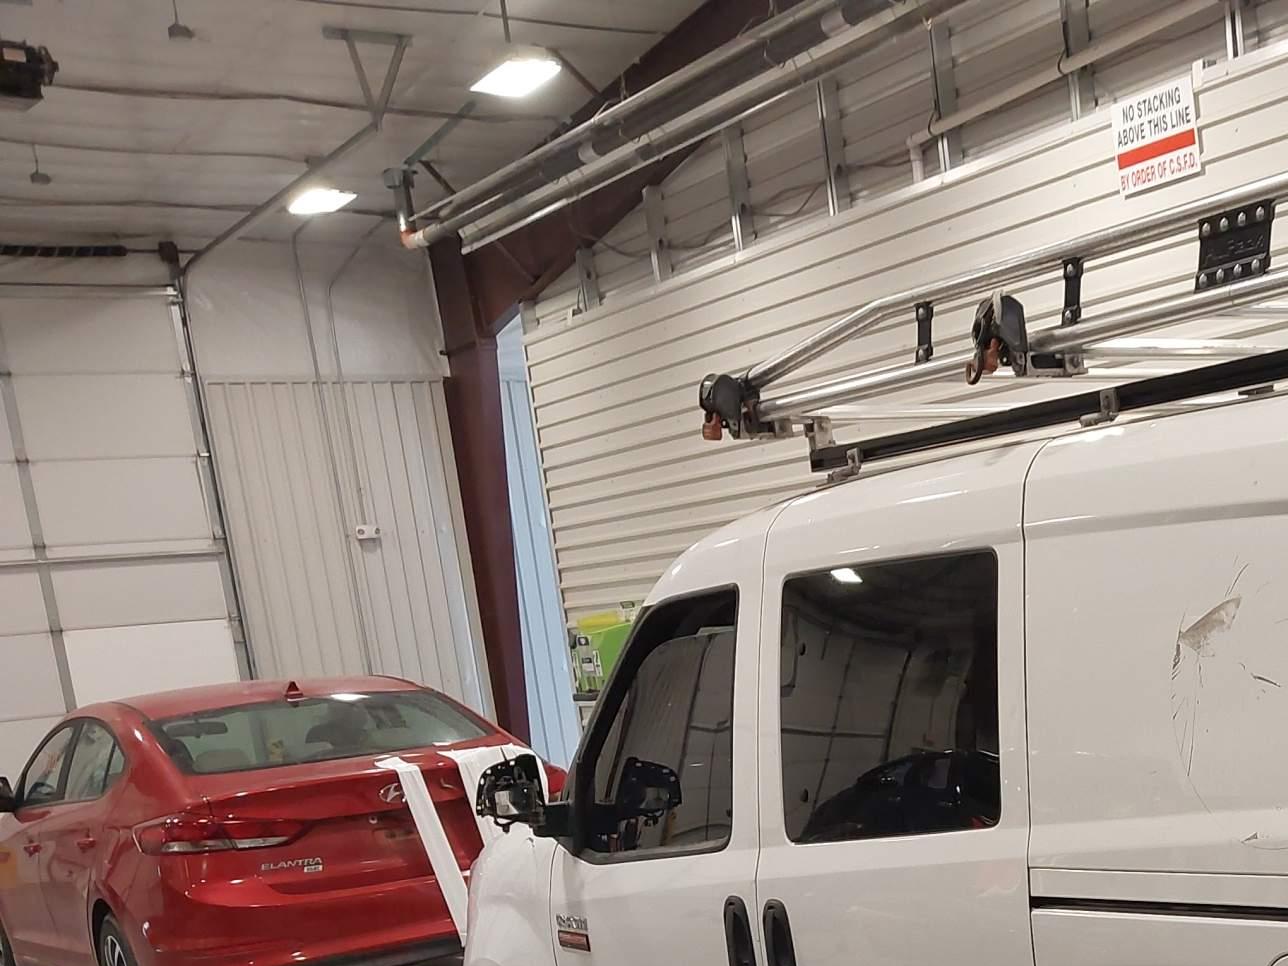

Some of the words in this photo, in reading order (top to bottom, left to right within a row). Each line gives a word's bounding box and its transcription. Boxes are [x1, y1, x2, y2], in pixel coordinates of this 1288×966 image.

[1122, 104, 1135, 124] NO
[1137, 87, 1181, 118] STACKING
[1118, 122, 1146, 148] ABOVE
[1148, 114, 1168, 138] THIS
[1170, 105, 1191, 129] LINE
[1121, 174, 1131, 191] BY
[1131, 165, 1157, 187] ORDER
[1157, 160, 1167, 179] OF
[1169, 152, 1198, 175] C.S.F.D.
[261, 857, 322, 870] ELANTRA
